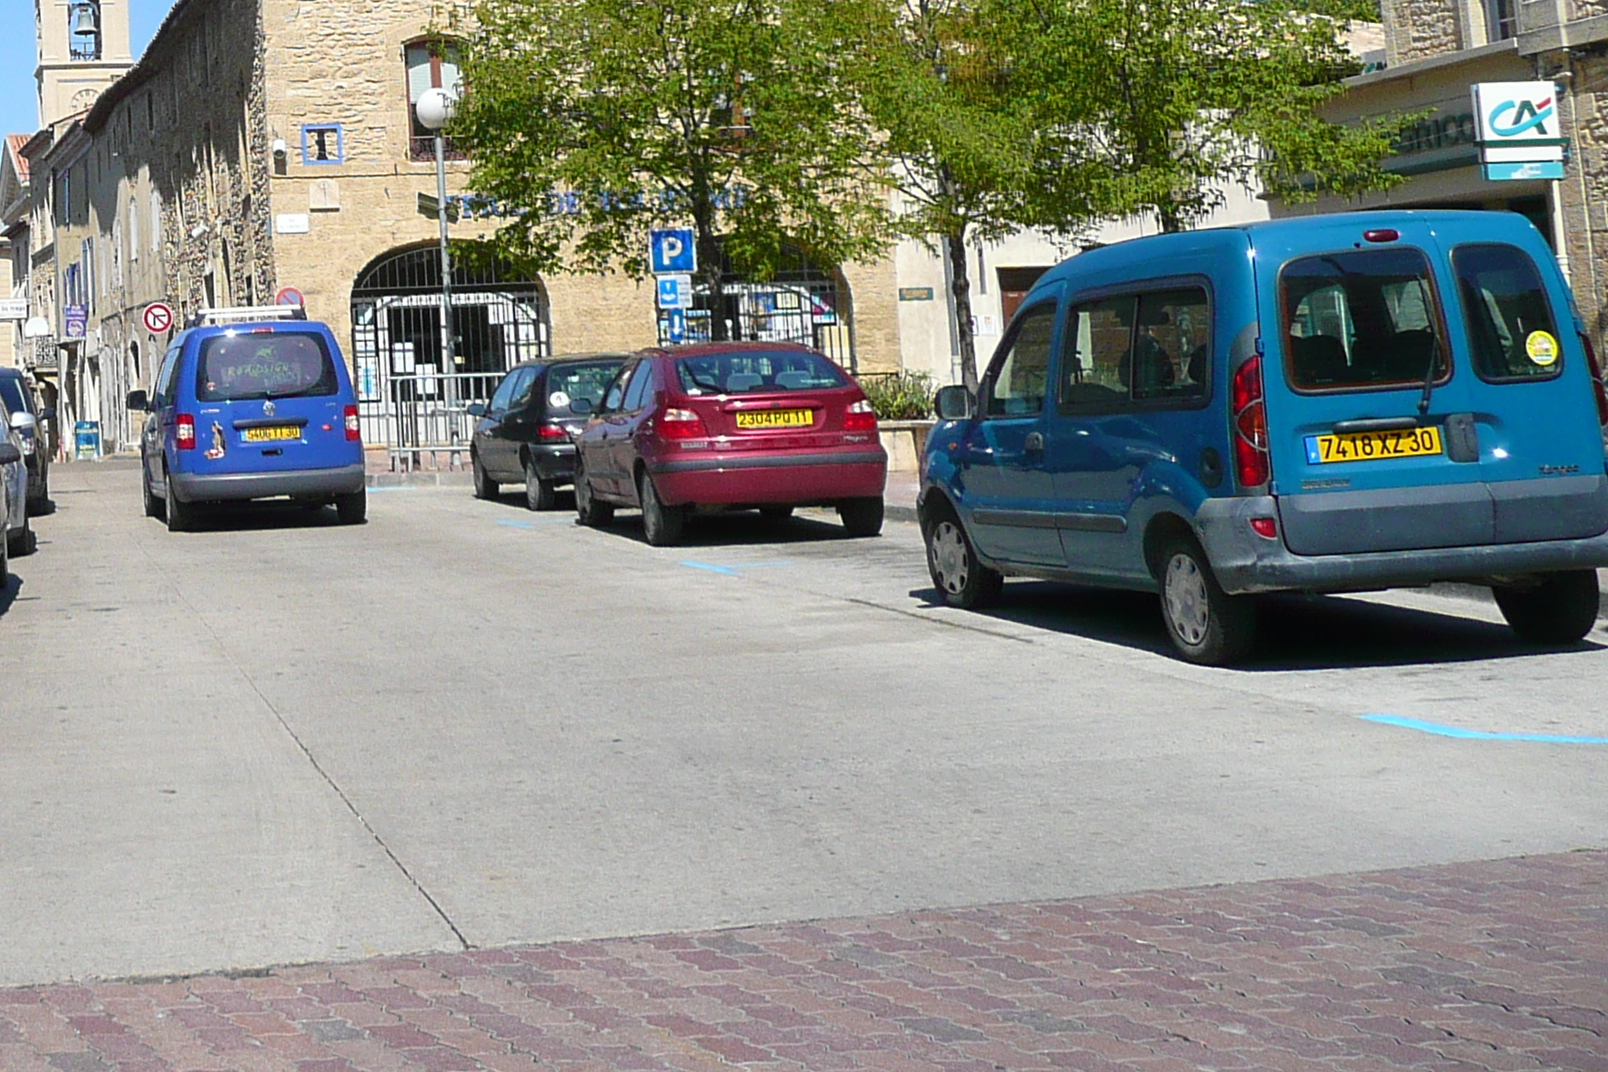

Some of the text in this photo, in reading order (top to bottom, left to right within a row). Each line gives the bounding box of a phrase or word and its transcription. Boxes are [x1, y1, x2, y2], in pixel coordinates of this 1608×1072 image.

[662, 236, 683, 266] P
[739, 412, 772, 425] 2304
[795, 410, 807, 423] 11
[1320, 430, 1434, 459] 7418 XZ 30
